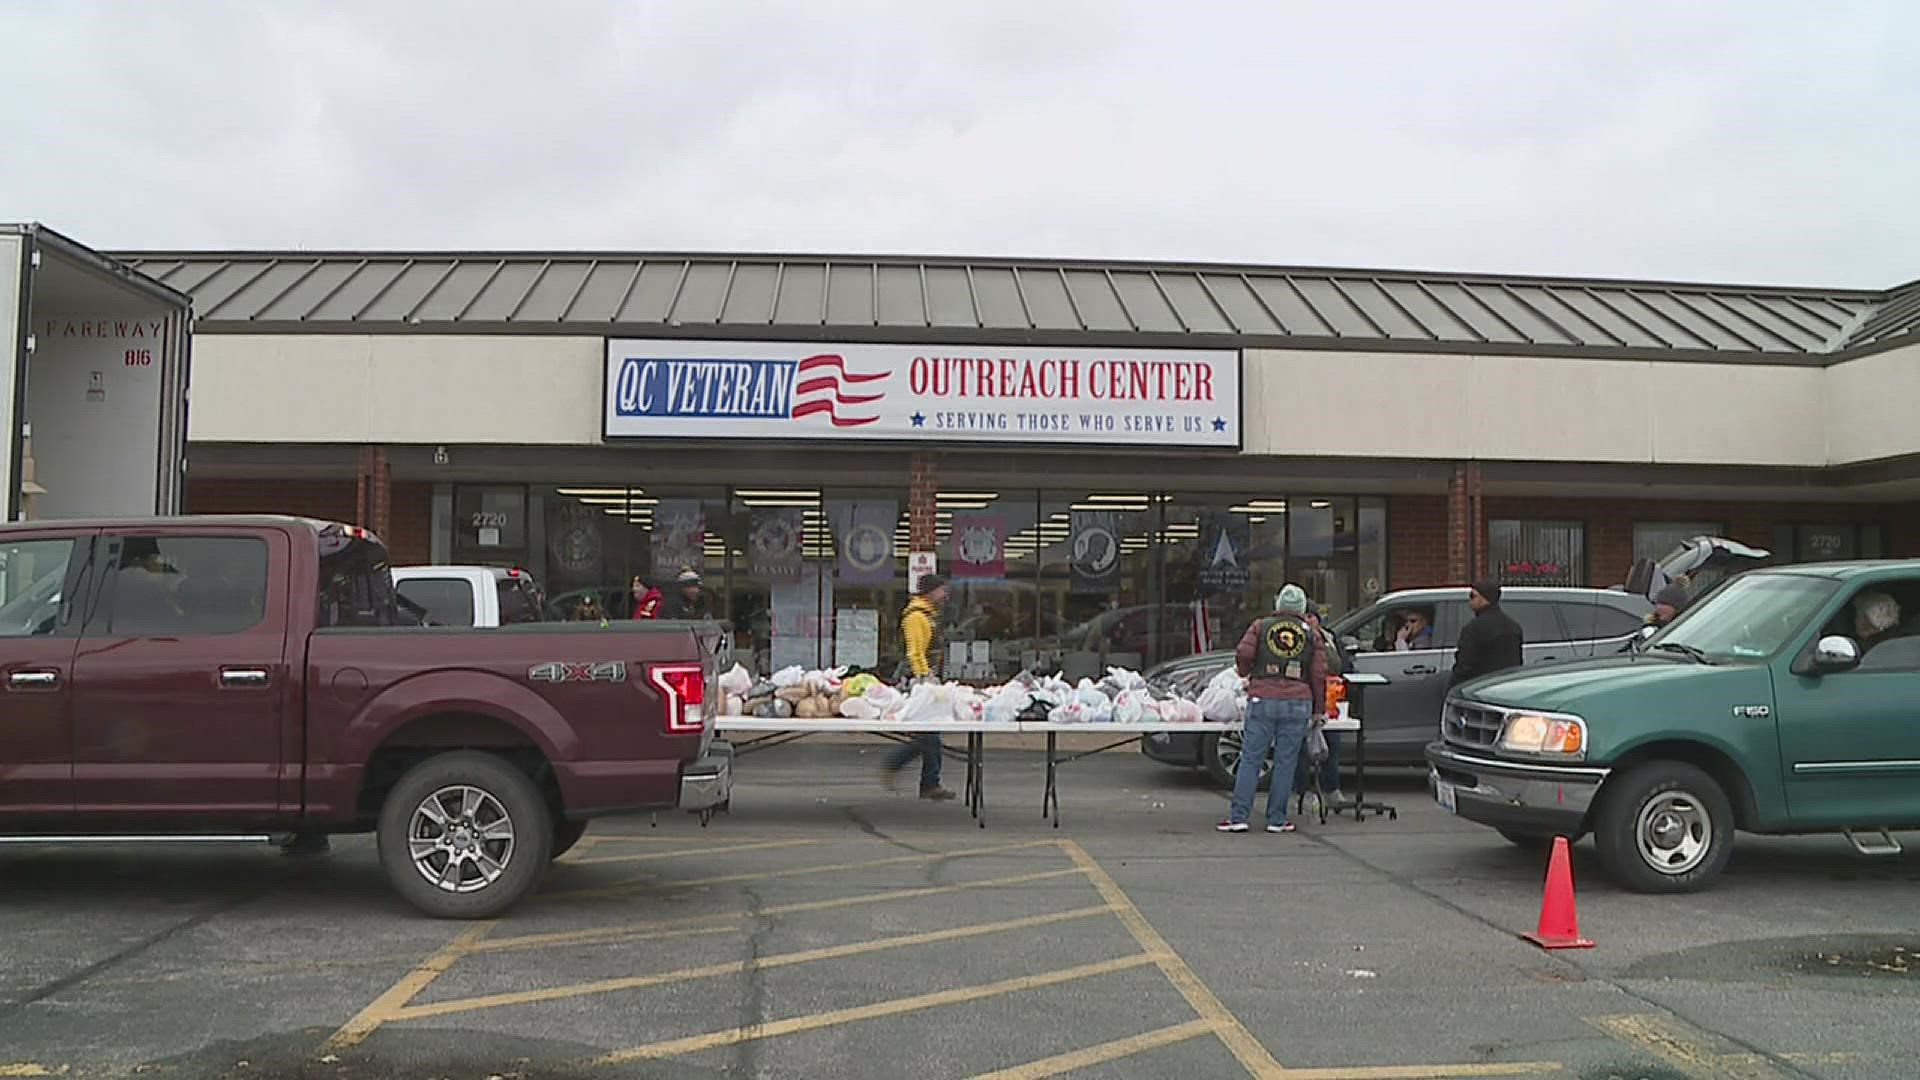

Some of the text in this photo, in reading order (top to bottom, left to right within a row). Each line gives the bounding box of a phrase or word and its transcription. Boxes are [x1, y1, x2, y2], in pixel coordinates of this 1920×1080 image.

[124, 349, 151, 367] 816
[619, 360, 792, 416] QC VETERAN
[909, 356, 1214, 401] OUTREACH CENTER
[935, 412, 1202, 433] SERVING THOSE WHO SERVE US
[472, 512, 507, 527] 2720
